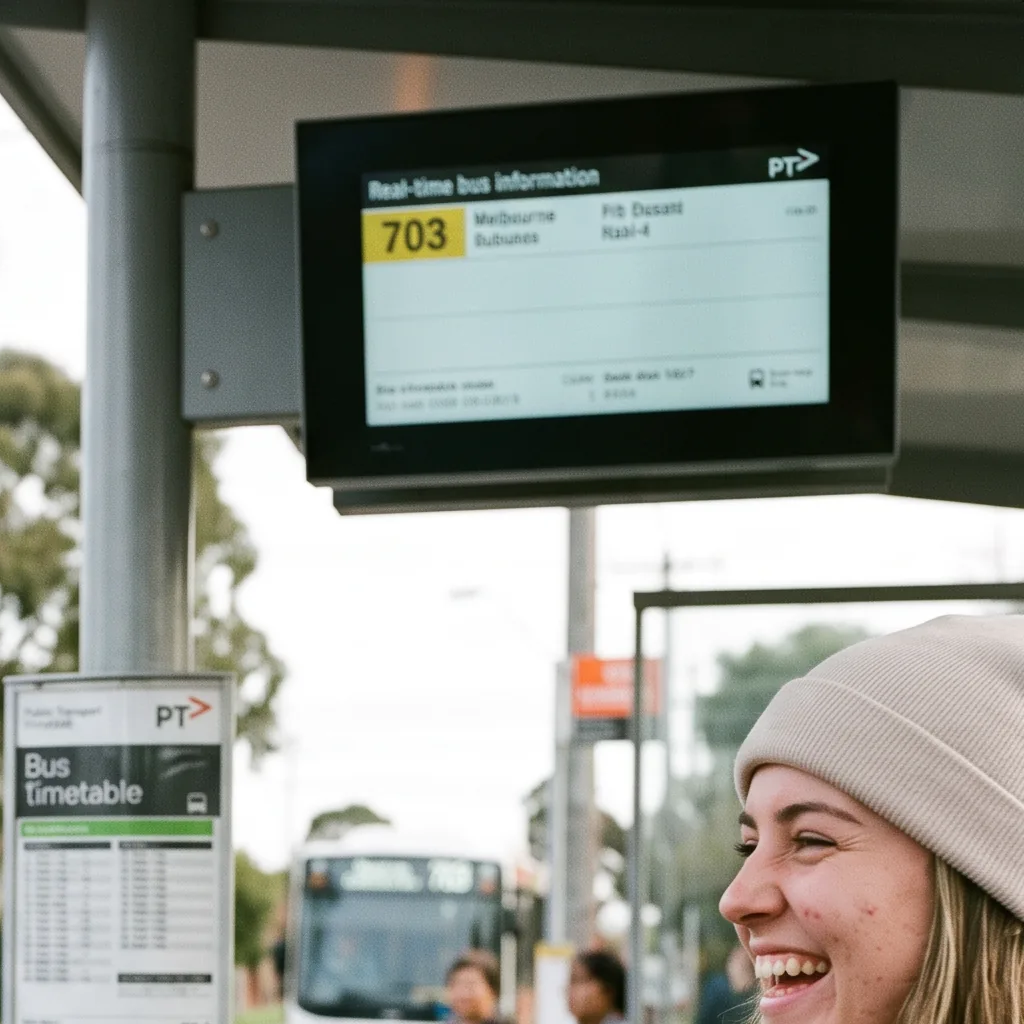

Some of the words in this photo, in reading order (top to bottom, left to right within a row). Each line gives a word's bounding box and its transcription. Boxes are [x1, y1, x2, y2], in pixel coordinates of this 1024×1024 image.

[368, 178, 454, 201] Real-time
[456, 174, 492, 196] bus
[494, 166, 601, 193] information
[382, 217, 447, 253] 703
[24, 752, 71, 779] Bus
